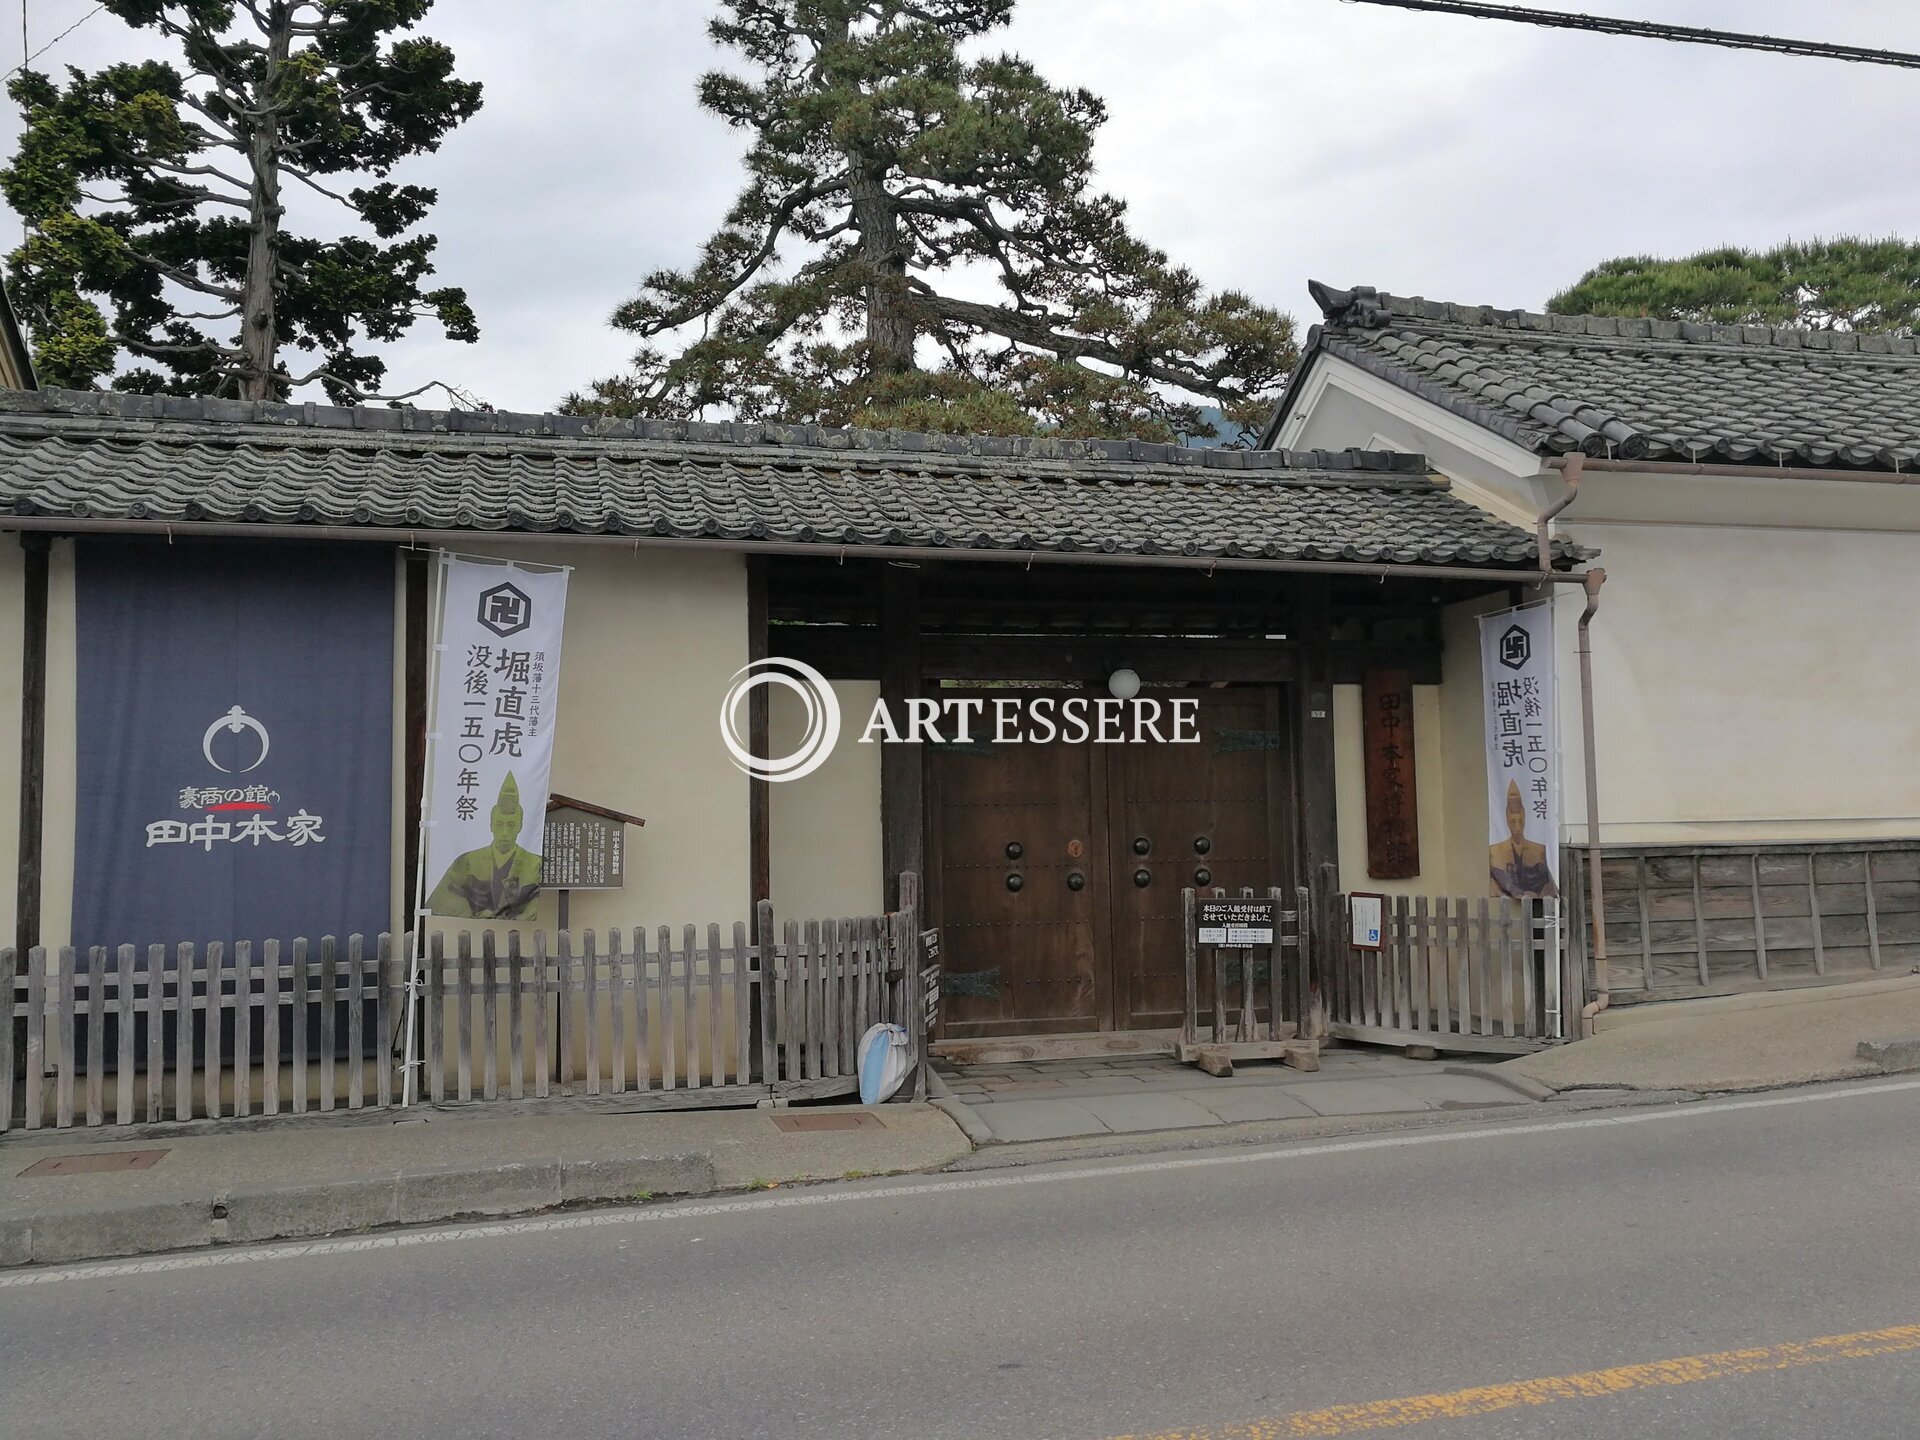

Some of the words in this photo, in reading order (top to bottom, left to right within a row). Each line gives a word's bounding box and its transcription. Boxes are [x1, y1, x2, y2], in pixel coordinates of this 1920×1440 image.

[489, 648, 531, 757] 堀直虎
[528, 651, 545, 737] 須坂藩十三代藩主
[456, 644, 493, 821] 没後一五〇年祭
[179, 784, 269, 810] 豪商の館
[145, 808, 327, 852] 田中本家
[1203, 905, 1272, 914] 本日のご入館受付は終了
[1203, 913, 1272, 922] させていただきました。
